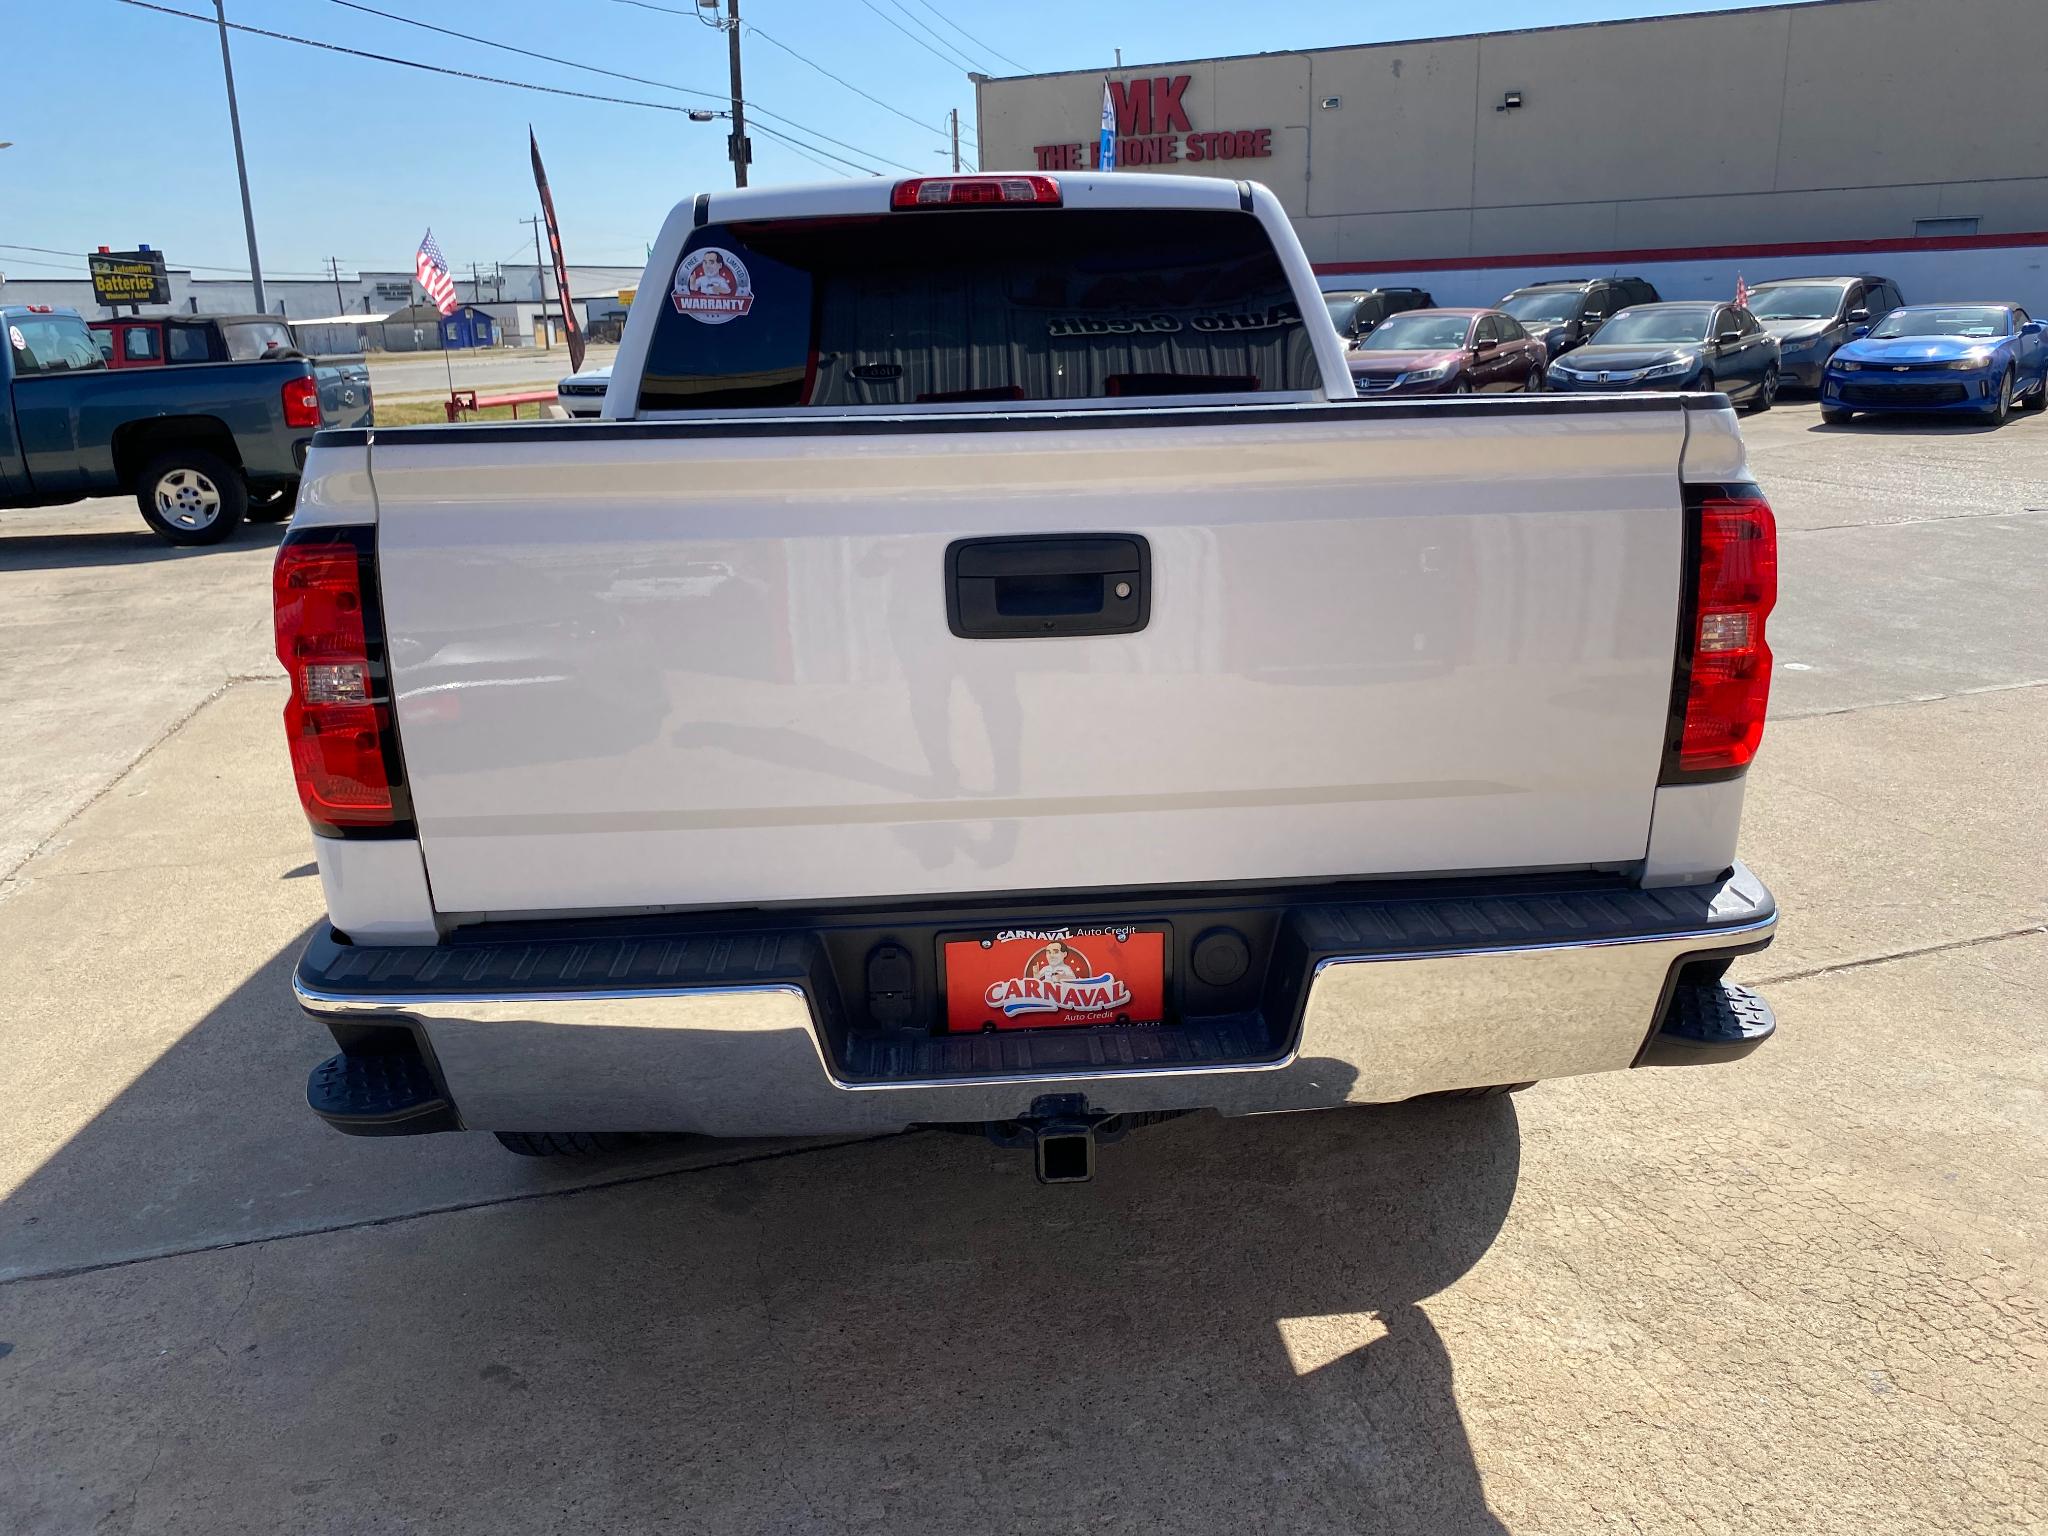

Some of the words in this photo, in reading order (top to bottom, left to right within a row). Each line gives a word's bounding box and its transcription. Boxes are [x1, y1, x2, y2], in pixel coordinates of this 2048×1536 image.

[1103, 75, 1192, 137] MK
[1034, 143, 1082, 170] THE
[1186, 129, 1272, 161] STORE
[684, 255, 698, 271] FREE
[726, 256, 745, 279] LIMITED
[96, 274, 154, 292] Batteries
[680, 297, 745, 310] WARRANTY
[996, 927, 1074, 943] CARNAVAL
[1076, 927, 1102, 937] Auto
[1104, 925, 1137, 935] Credit
[985, 976, 1131, 1011] CARNAVAL
[1063, 1012, 1085, 1022] Auto
[1086, 1011, 1113, 1021] Credit
